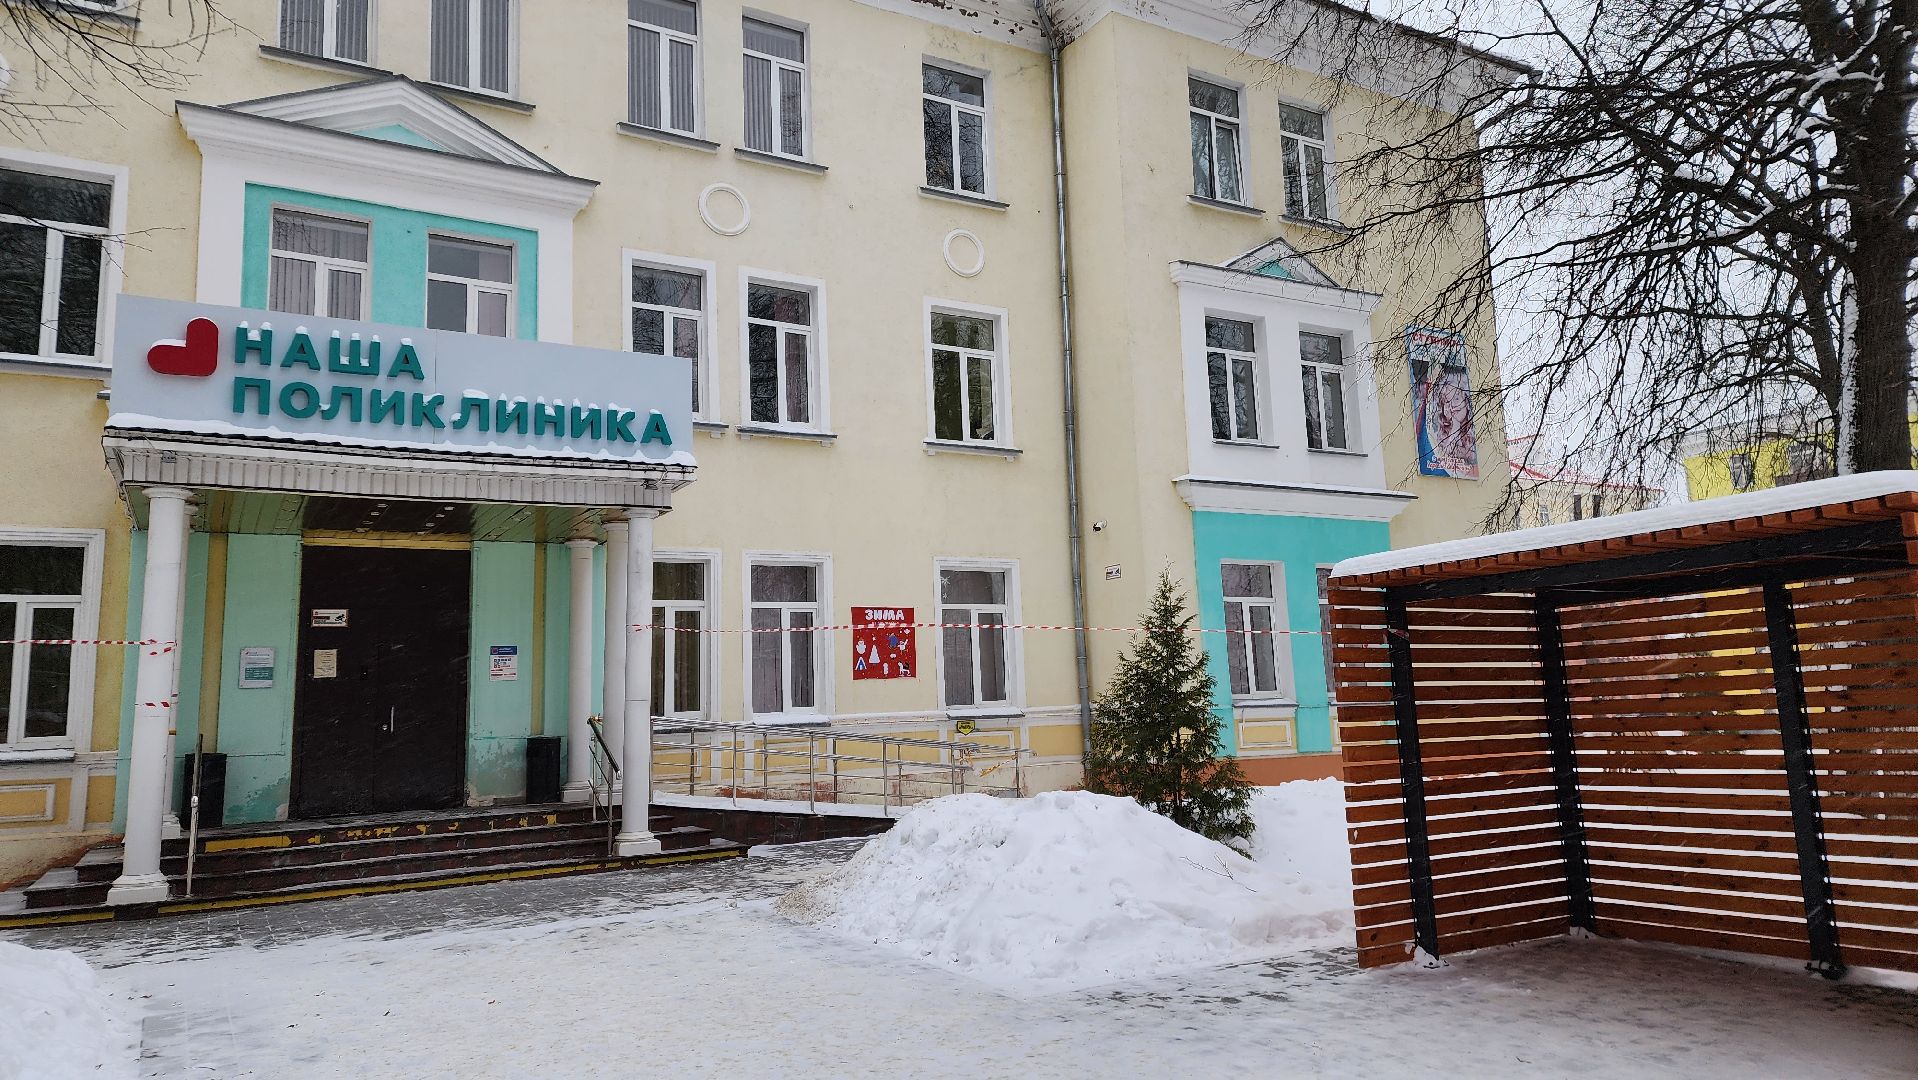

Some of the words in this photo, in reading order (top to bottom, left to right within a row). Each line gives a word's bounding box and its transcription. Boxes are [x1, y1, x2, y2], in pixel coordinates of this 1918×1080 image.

[235, 324, 425, 381] НАША
[233, 377, 673, 446] ПОЛИКЛИНИКА
[865, 609, 905, 621] ЗИМА
